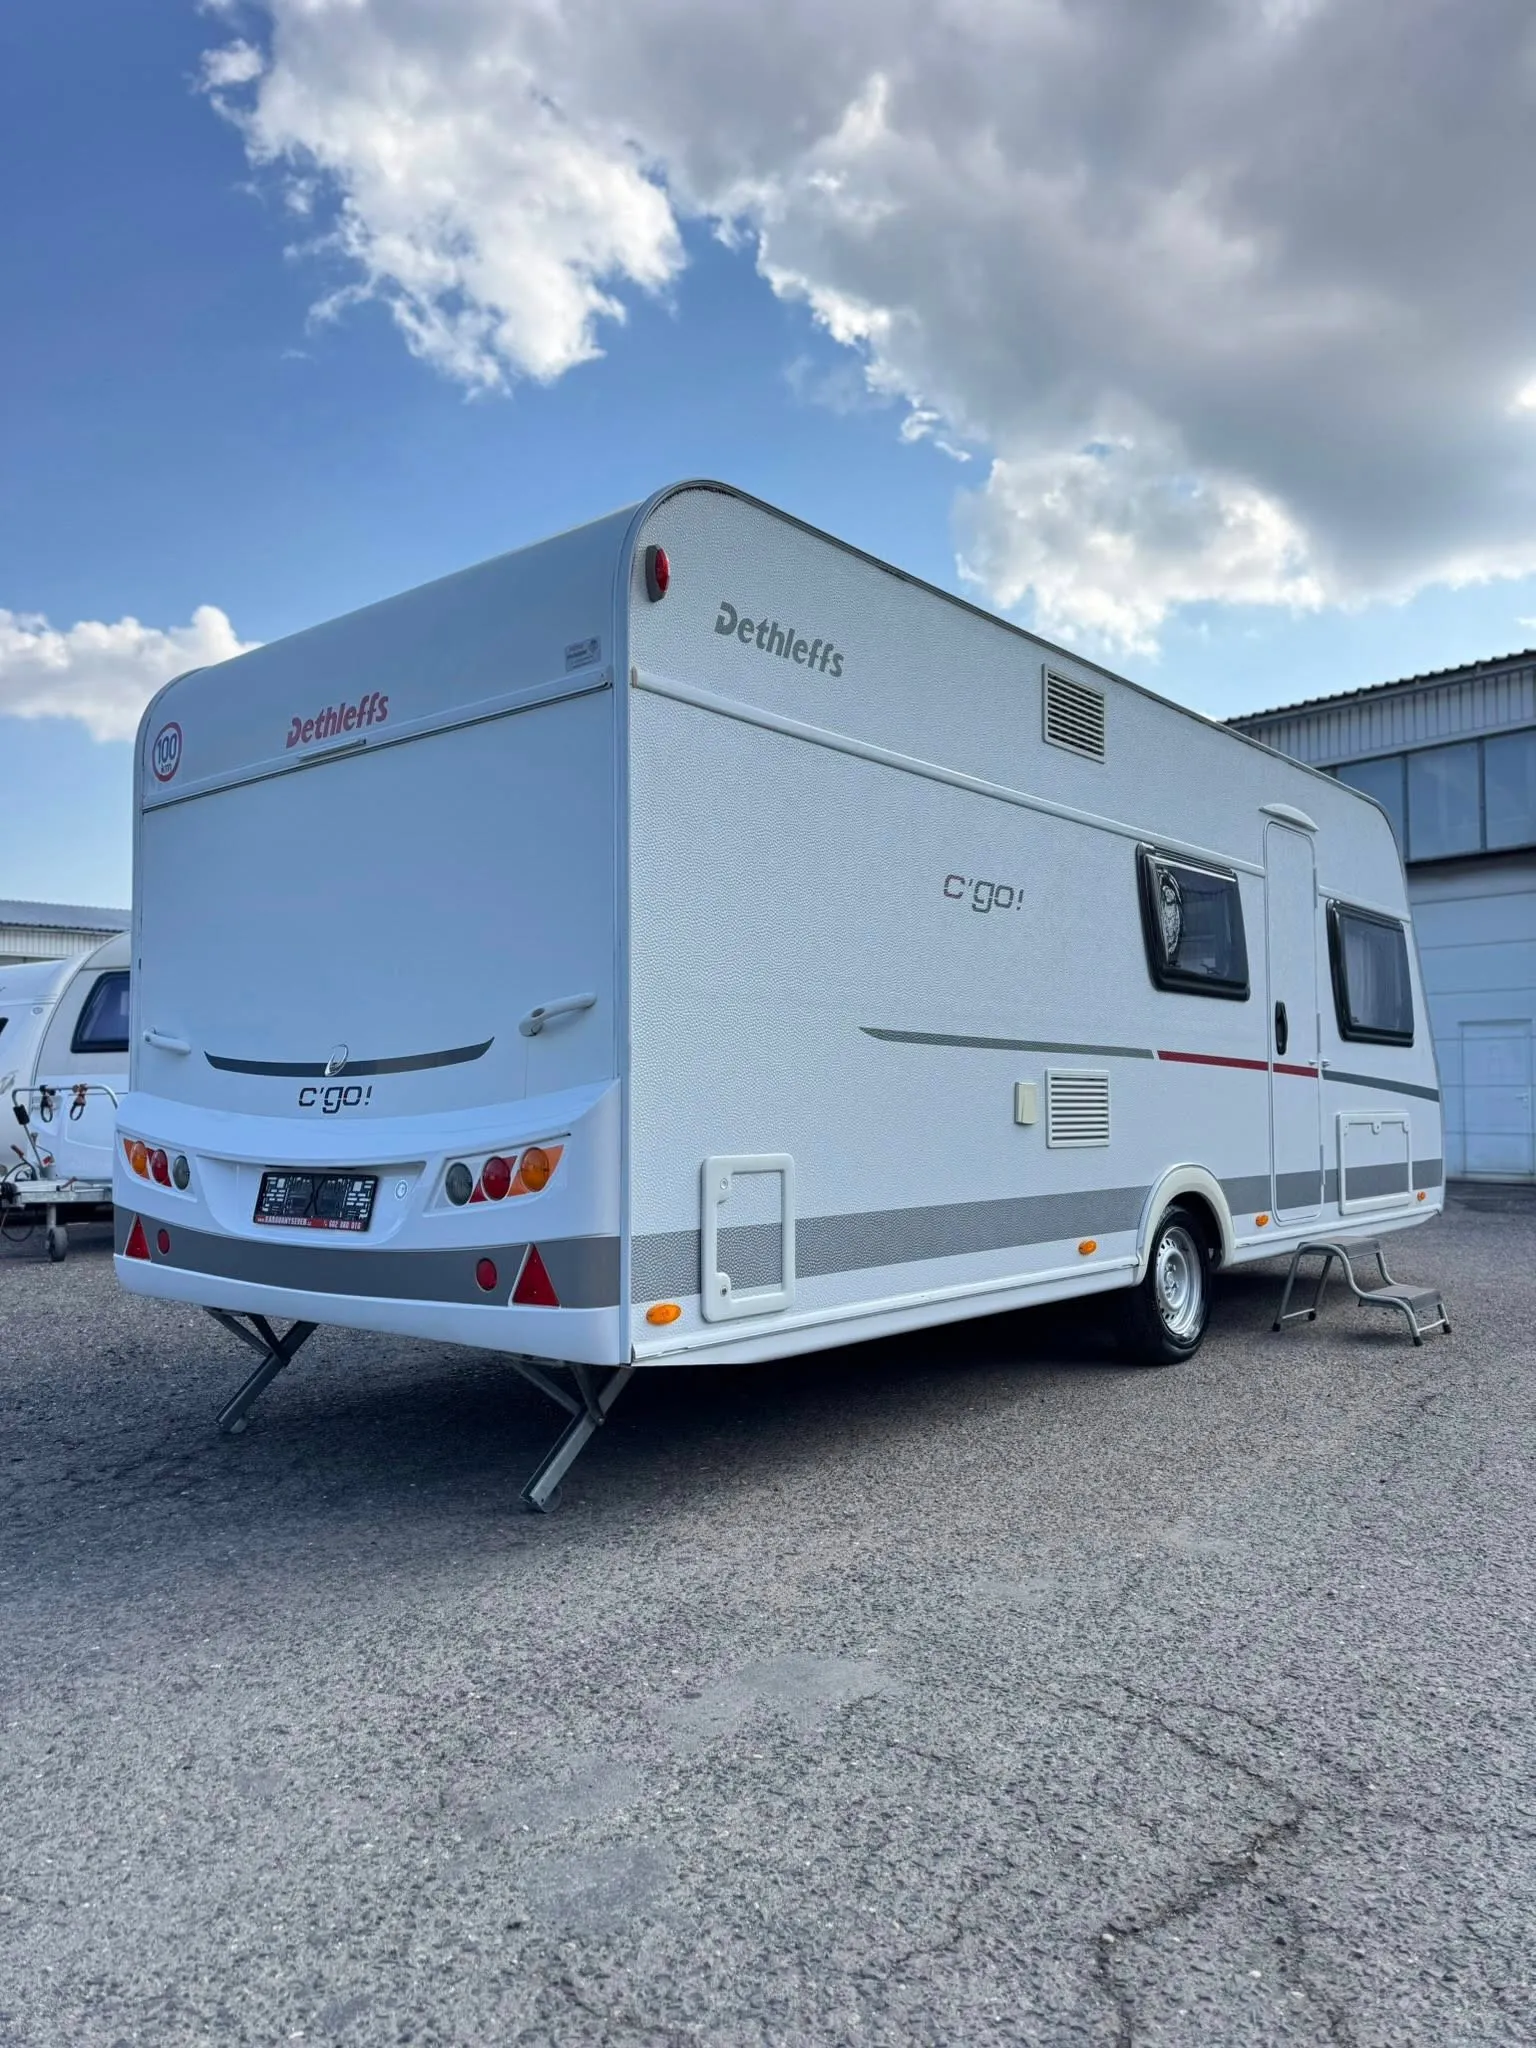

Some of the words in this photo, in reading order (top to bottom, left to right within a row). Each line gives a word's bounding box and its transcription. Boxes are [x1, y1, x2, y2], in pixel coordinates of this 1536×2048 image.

[714, 600, 844, 678] Dethleffs
[157, 732, 178, 765] 100
[286, 691, 389, 749] Dethleffs
